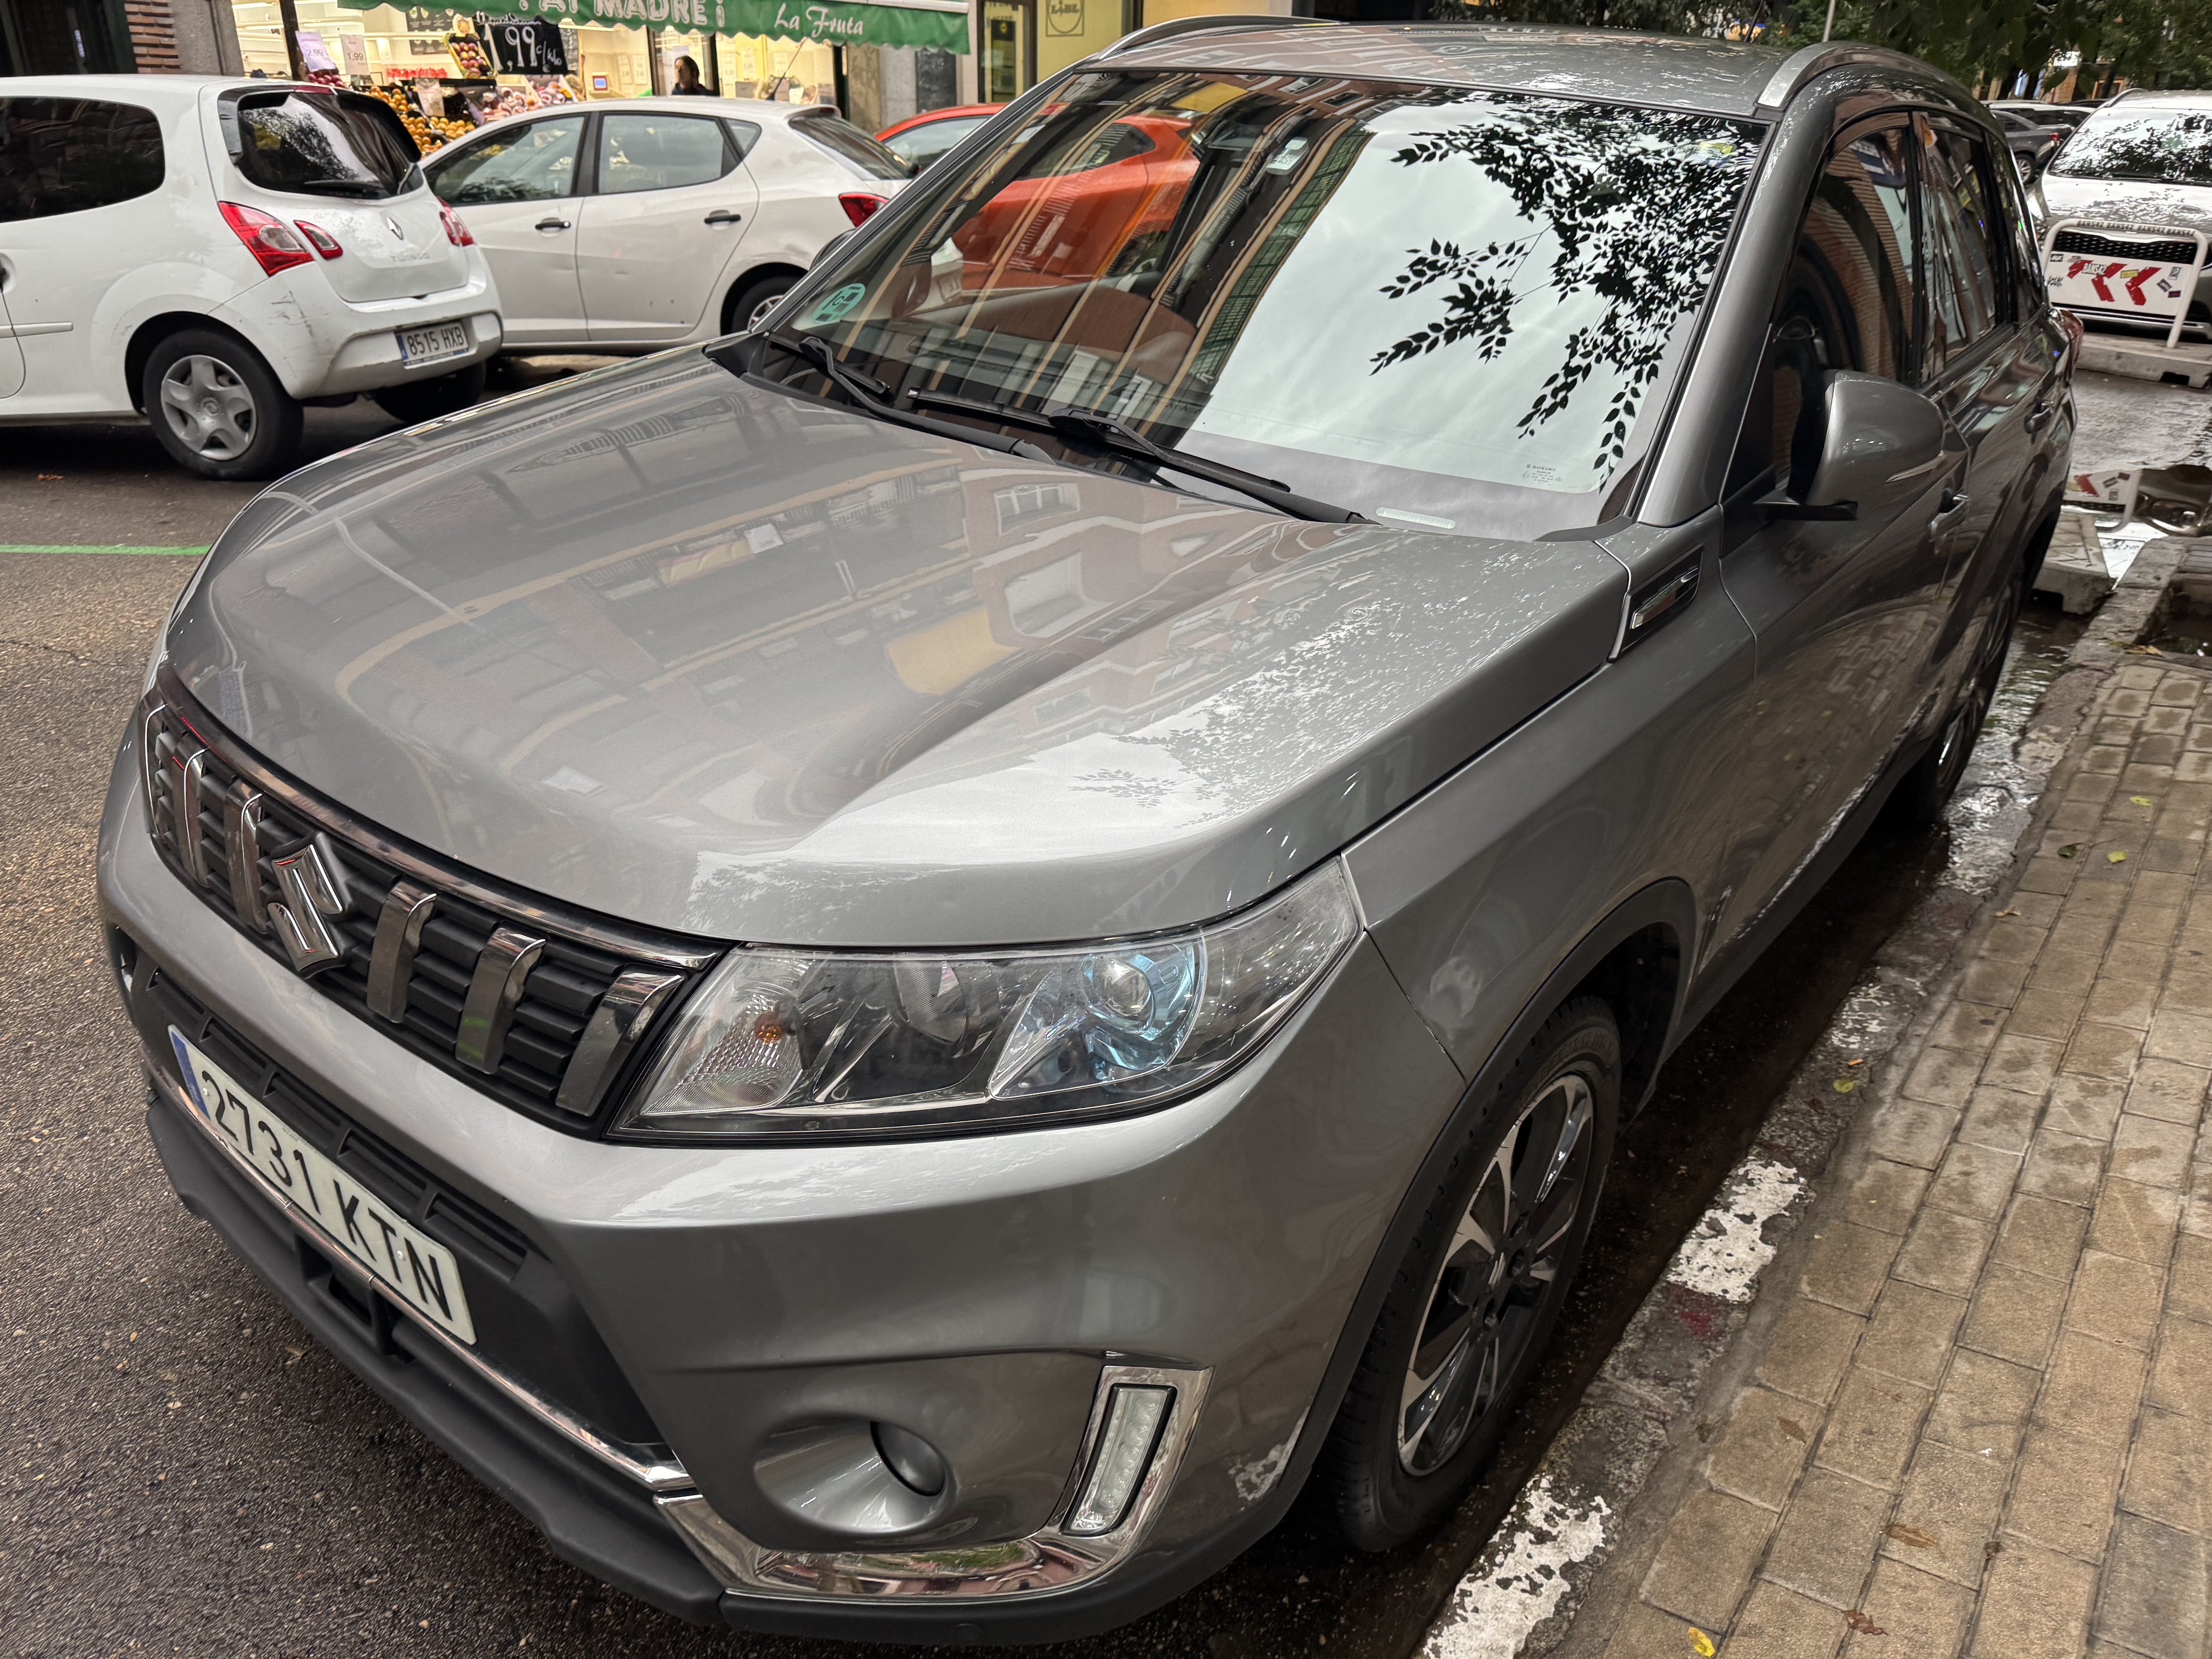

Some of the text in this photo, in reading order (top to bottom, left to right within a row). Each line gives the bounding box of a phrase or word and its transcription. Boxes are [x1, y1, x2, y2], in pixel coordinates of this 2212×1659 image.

[774, 3, 864, 38] La Fruta
[407, 326, 464, 356] 8515 HXB
[201, 1070, 453, 1322] 2731 KTN
